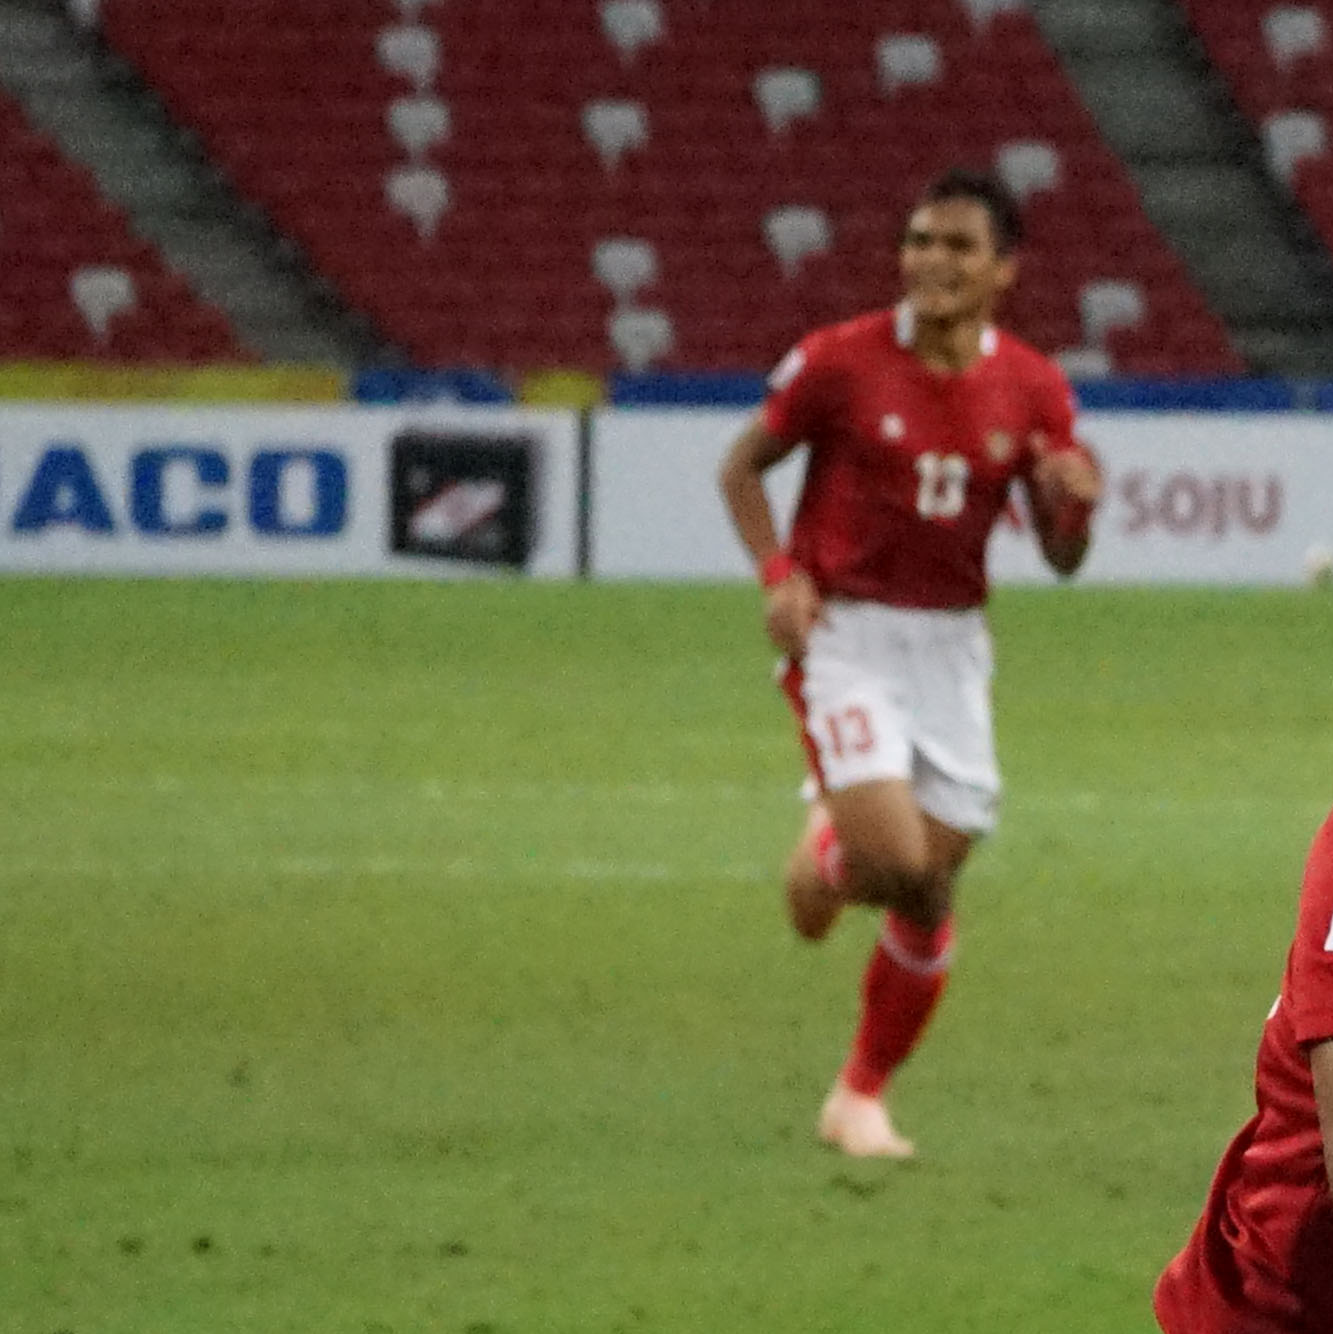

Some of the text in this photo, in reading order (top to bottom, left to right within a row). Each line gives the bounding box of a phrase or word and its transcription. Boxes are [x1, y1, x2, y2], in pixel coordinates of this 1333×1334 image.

[11, 444, 348, 536] ACO
[1119, 472, 1283, 534] SOJU
[825, 706, 874, 760] 13
